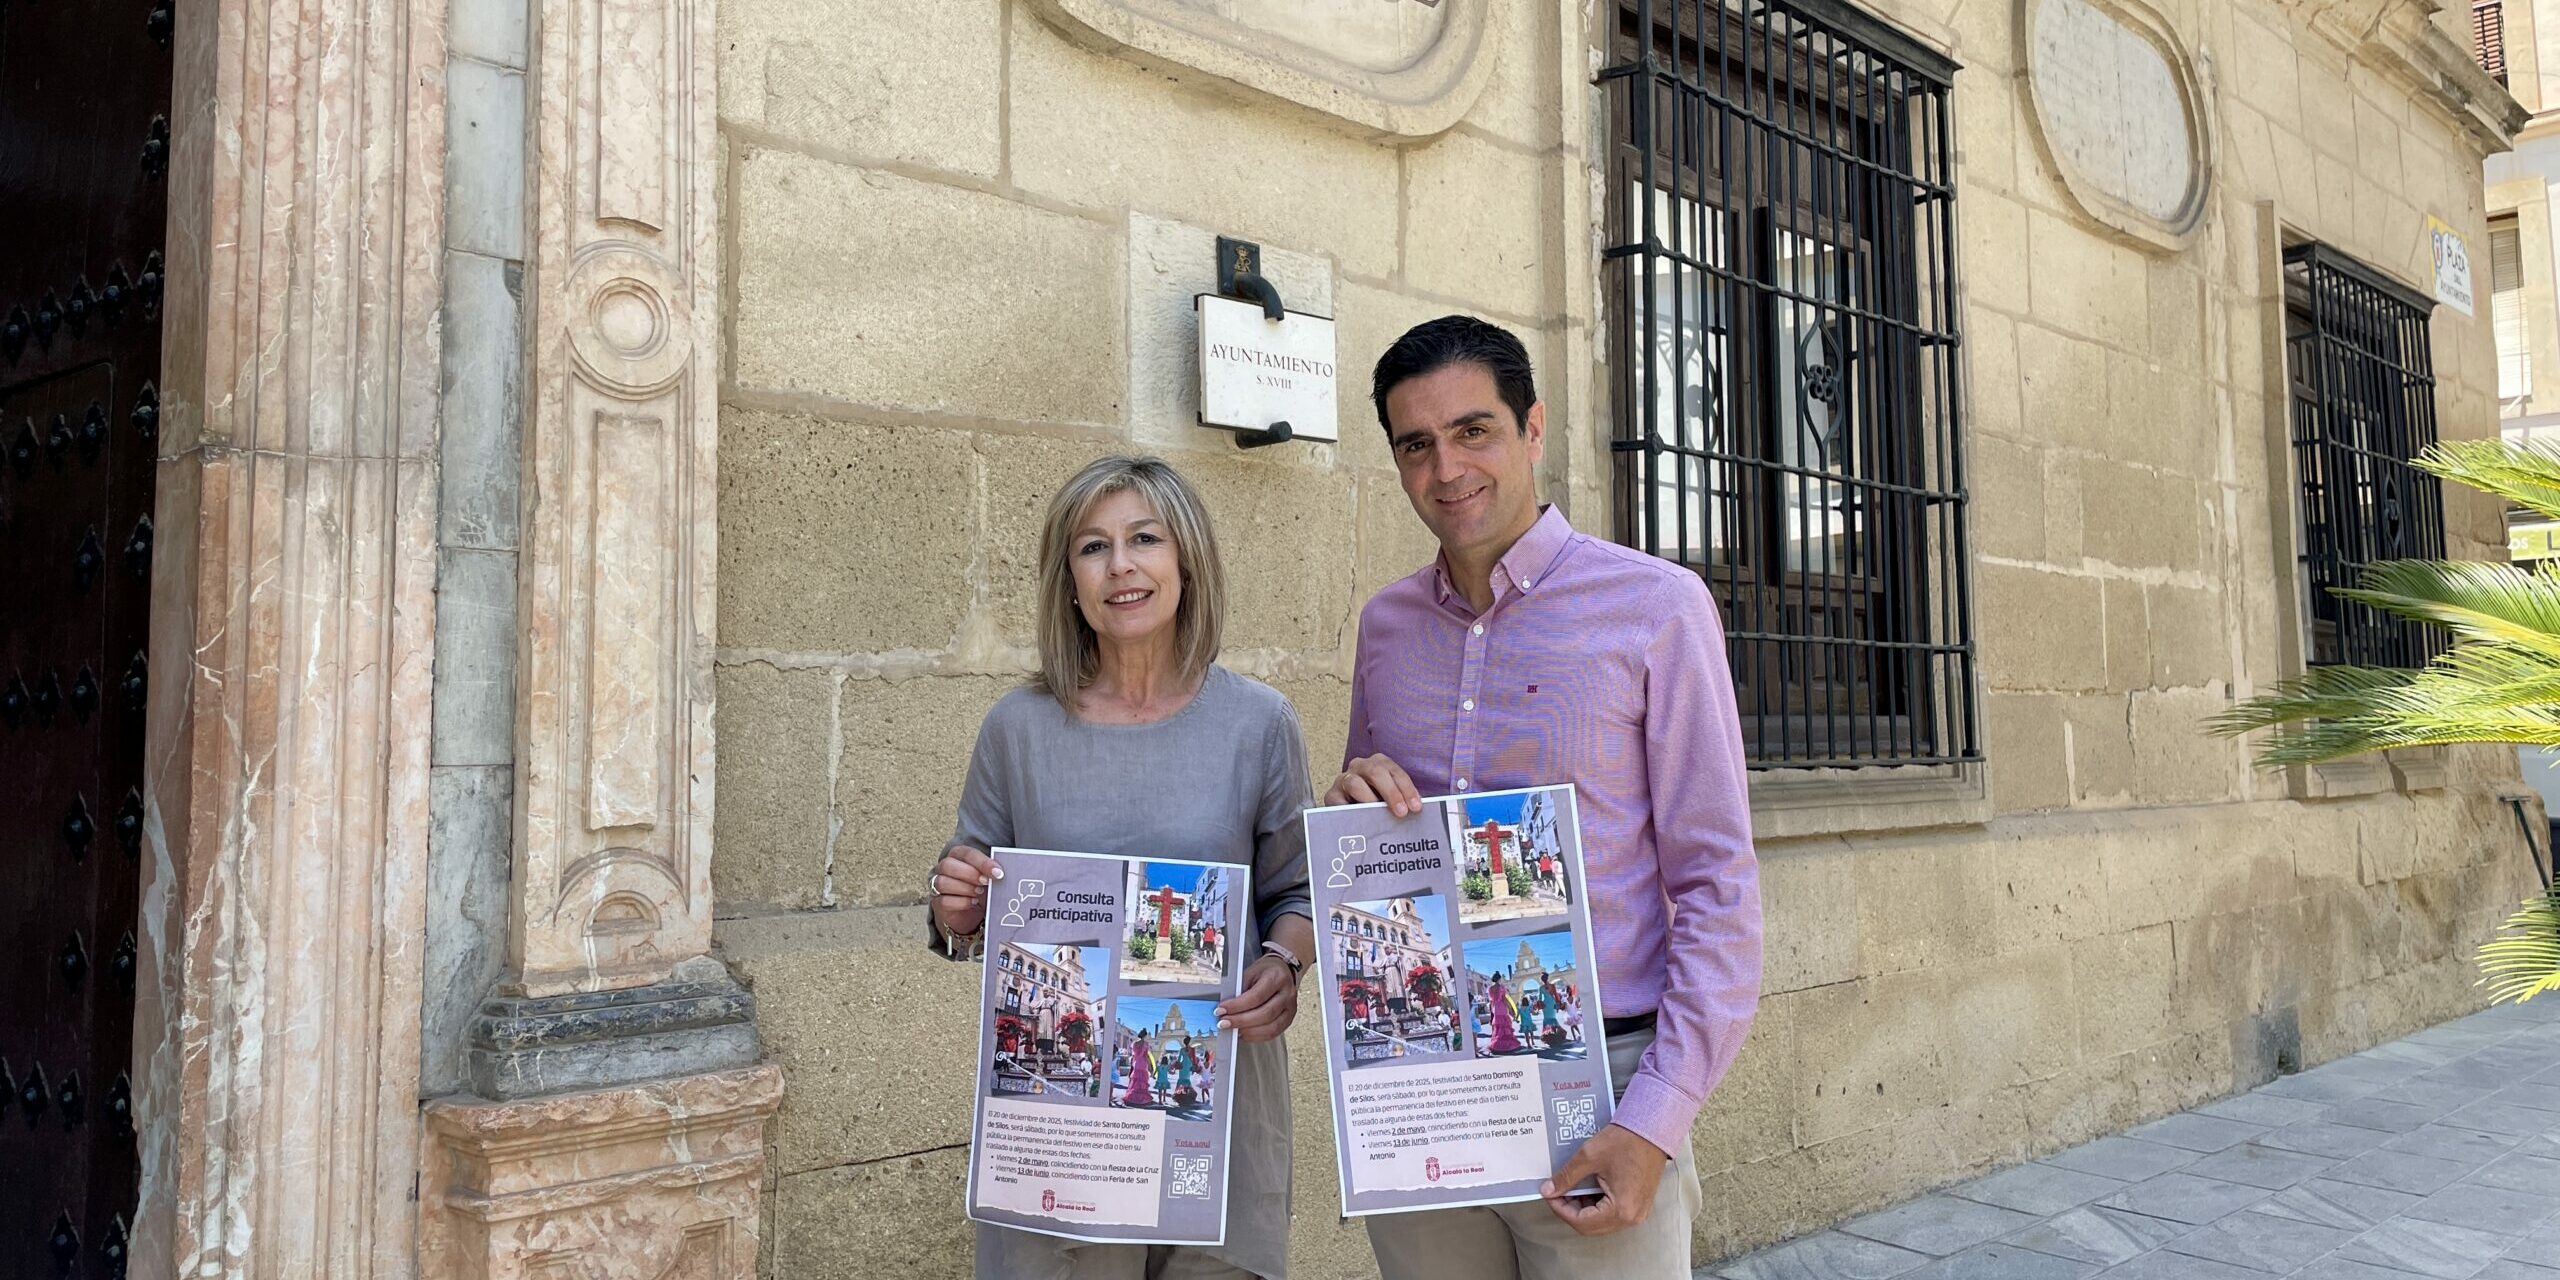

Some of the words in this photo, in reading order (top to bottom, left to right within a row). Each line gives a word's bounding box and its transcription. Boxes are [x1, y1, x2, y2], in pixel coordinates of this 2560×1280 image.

[2447, 245, 2465, 273] PLAZA
[2440, 280, 2470, 306] AYUNTAMIENTO
[1211, 344, 1332, 377] AYUNTAMIENTO
[1256, 375, 1264, 384] S.
[1267, 376, 1291, 389] XVIII
[1380, 838, 1439, 855] Consulta
[1355, 857, 1441, 877] participativa
[1057, 891, 1114, 905] Consulta
[1030, 908, 1112, 923] participativa
[1373, 1081, 1405, 1089] diciembre
[1433, 1075, 1462, 1084] festividad
[1493, 1070, 1523, 1079] Domingo
[1449, 1086, 1487, 1094] sometemos
[1351, 1107, 1374, 1116] pública
[1382, 1102, 1424, 1113] permanencia
[1009, 1113, 1038, 1122] diciembre
[1064, 1118, 1092, 1127] festividad
[1102, 1121, 1120, 1129] Santo
[1122, 1122, 1150, 1130] Domingo
[1385, 1116, 1406, 1124] alguna
[1416, 1112, 1433, 1120] estas
[1078, 1131, 1113, 1139] sometemos
[1392, 1128, 1396, 1136] 2
[1428, 1121, 1468, 1131] coincidiendo
[1013, 1135, 1052, 1144] permanencia
[1393, 1139, 1401, 1148] 13
[1431, 1133, 1471, 1143] coincidiendo
[1014, 1145, 1033, 1154] alguna
[1370, 1152, 1395, 1160] Antonio
[996, 1164, 1016, 1172] Viernes
[1025, 1168, 1033, 1176] de
[1052, 1171, 1089, 1180] coincidiendo
[1051, 1160, 1089, 1169] coincidiendo
